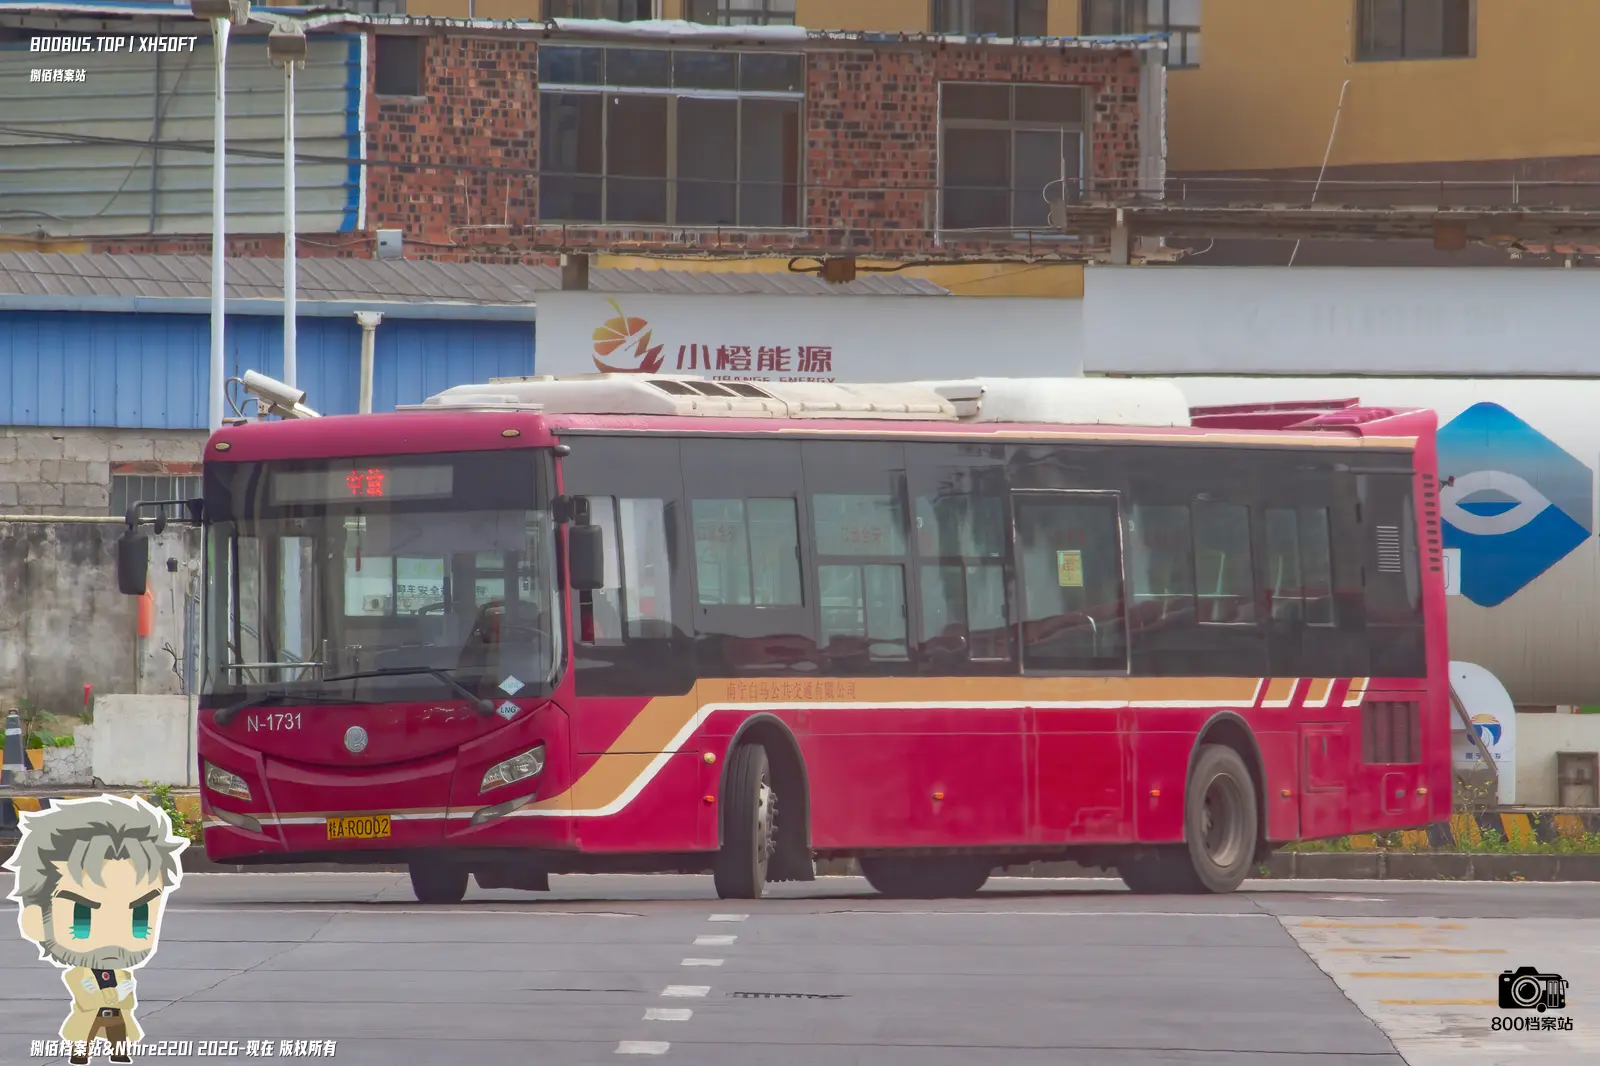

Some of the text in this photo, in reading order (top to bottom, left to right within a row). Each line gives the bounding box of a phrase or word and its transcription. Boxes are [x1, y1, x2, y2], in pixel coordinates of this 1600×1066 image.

[676, 343, 833, 373] 小橙能源
[726, 680, 857, 701] 南宁白马公共交通有限公司
[500, 706, 517, 714] LNG
[247, 712, 302, 732] N-1731
